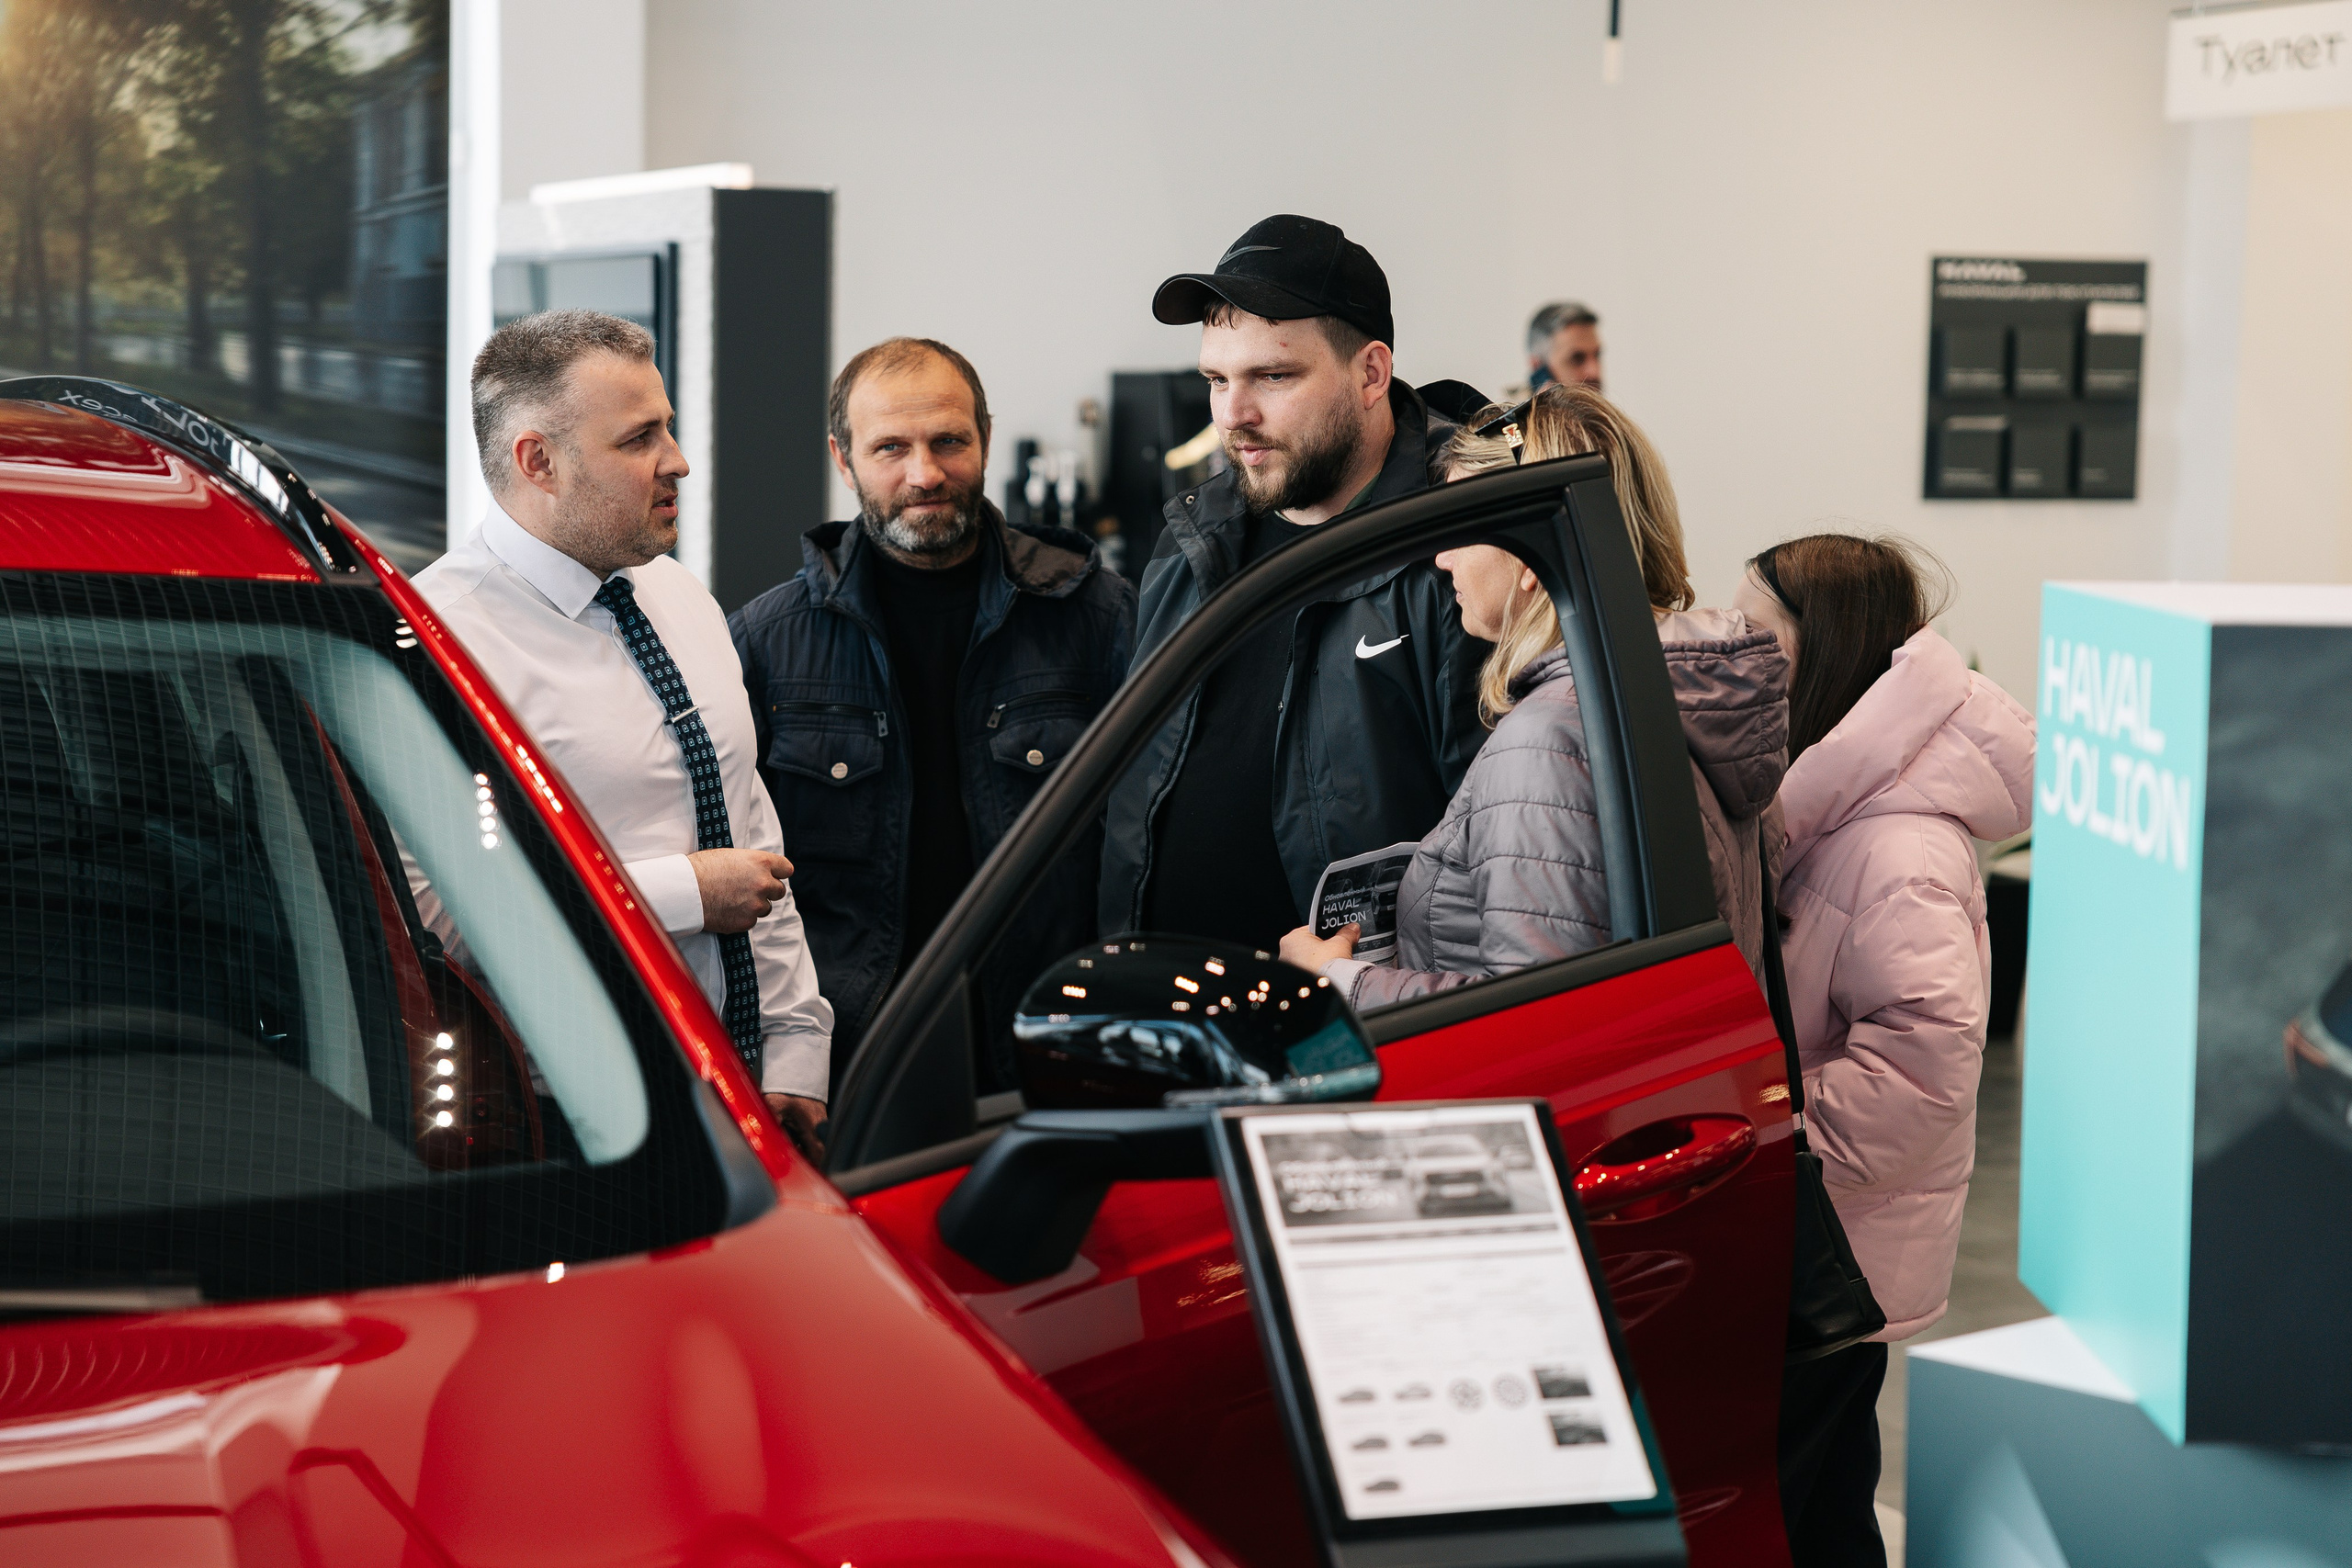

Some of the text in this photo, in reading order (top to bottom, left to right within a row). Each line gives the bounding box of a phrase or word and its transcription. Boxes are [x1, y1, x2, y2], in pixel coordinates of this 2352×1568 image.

[2195, 32, 2346, 85] Туалет
[2041, 635, 2165, 756] HAVAL
[2040, 733, 2191, 870] JOLION
[1321, 910, 1367, 930] JOLION
[1322, 897, 1360, 915] HAVAL
